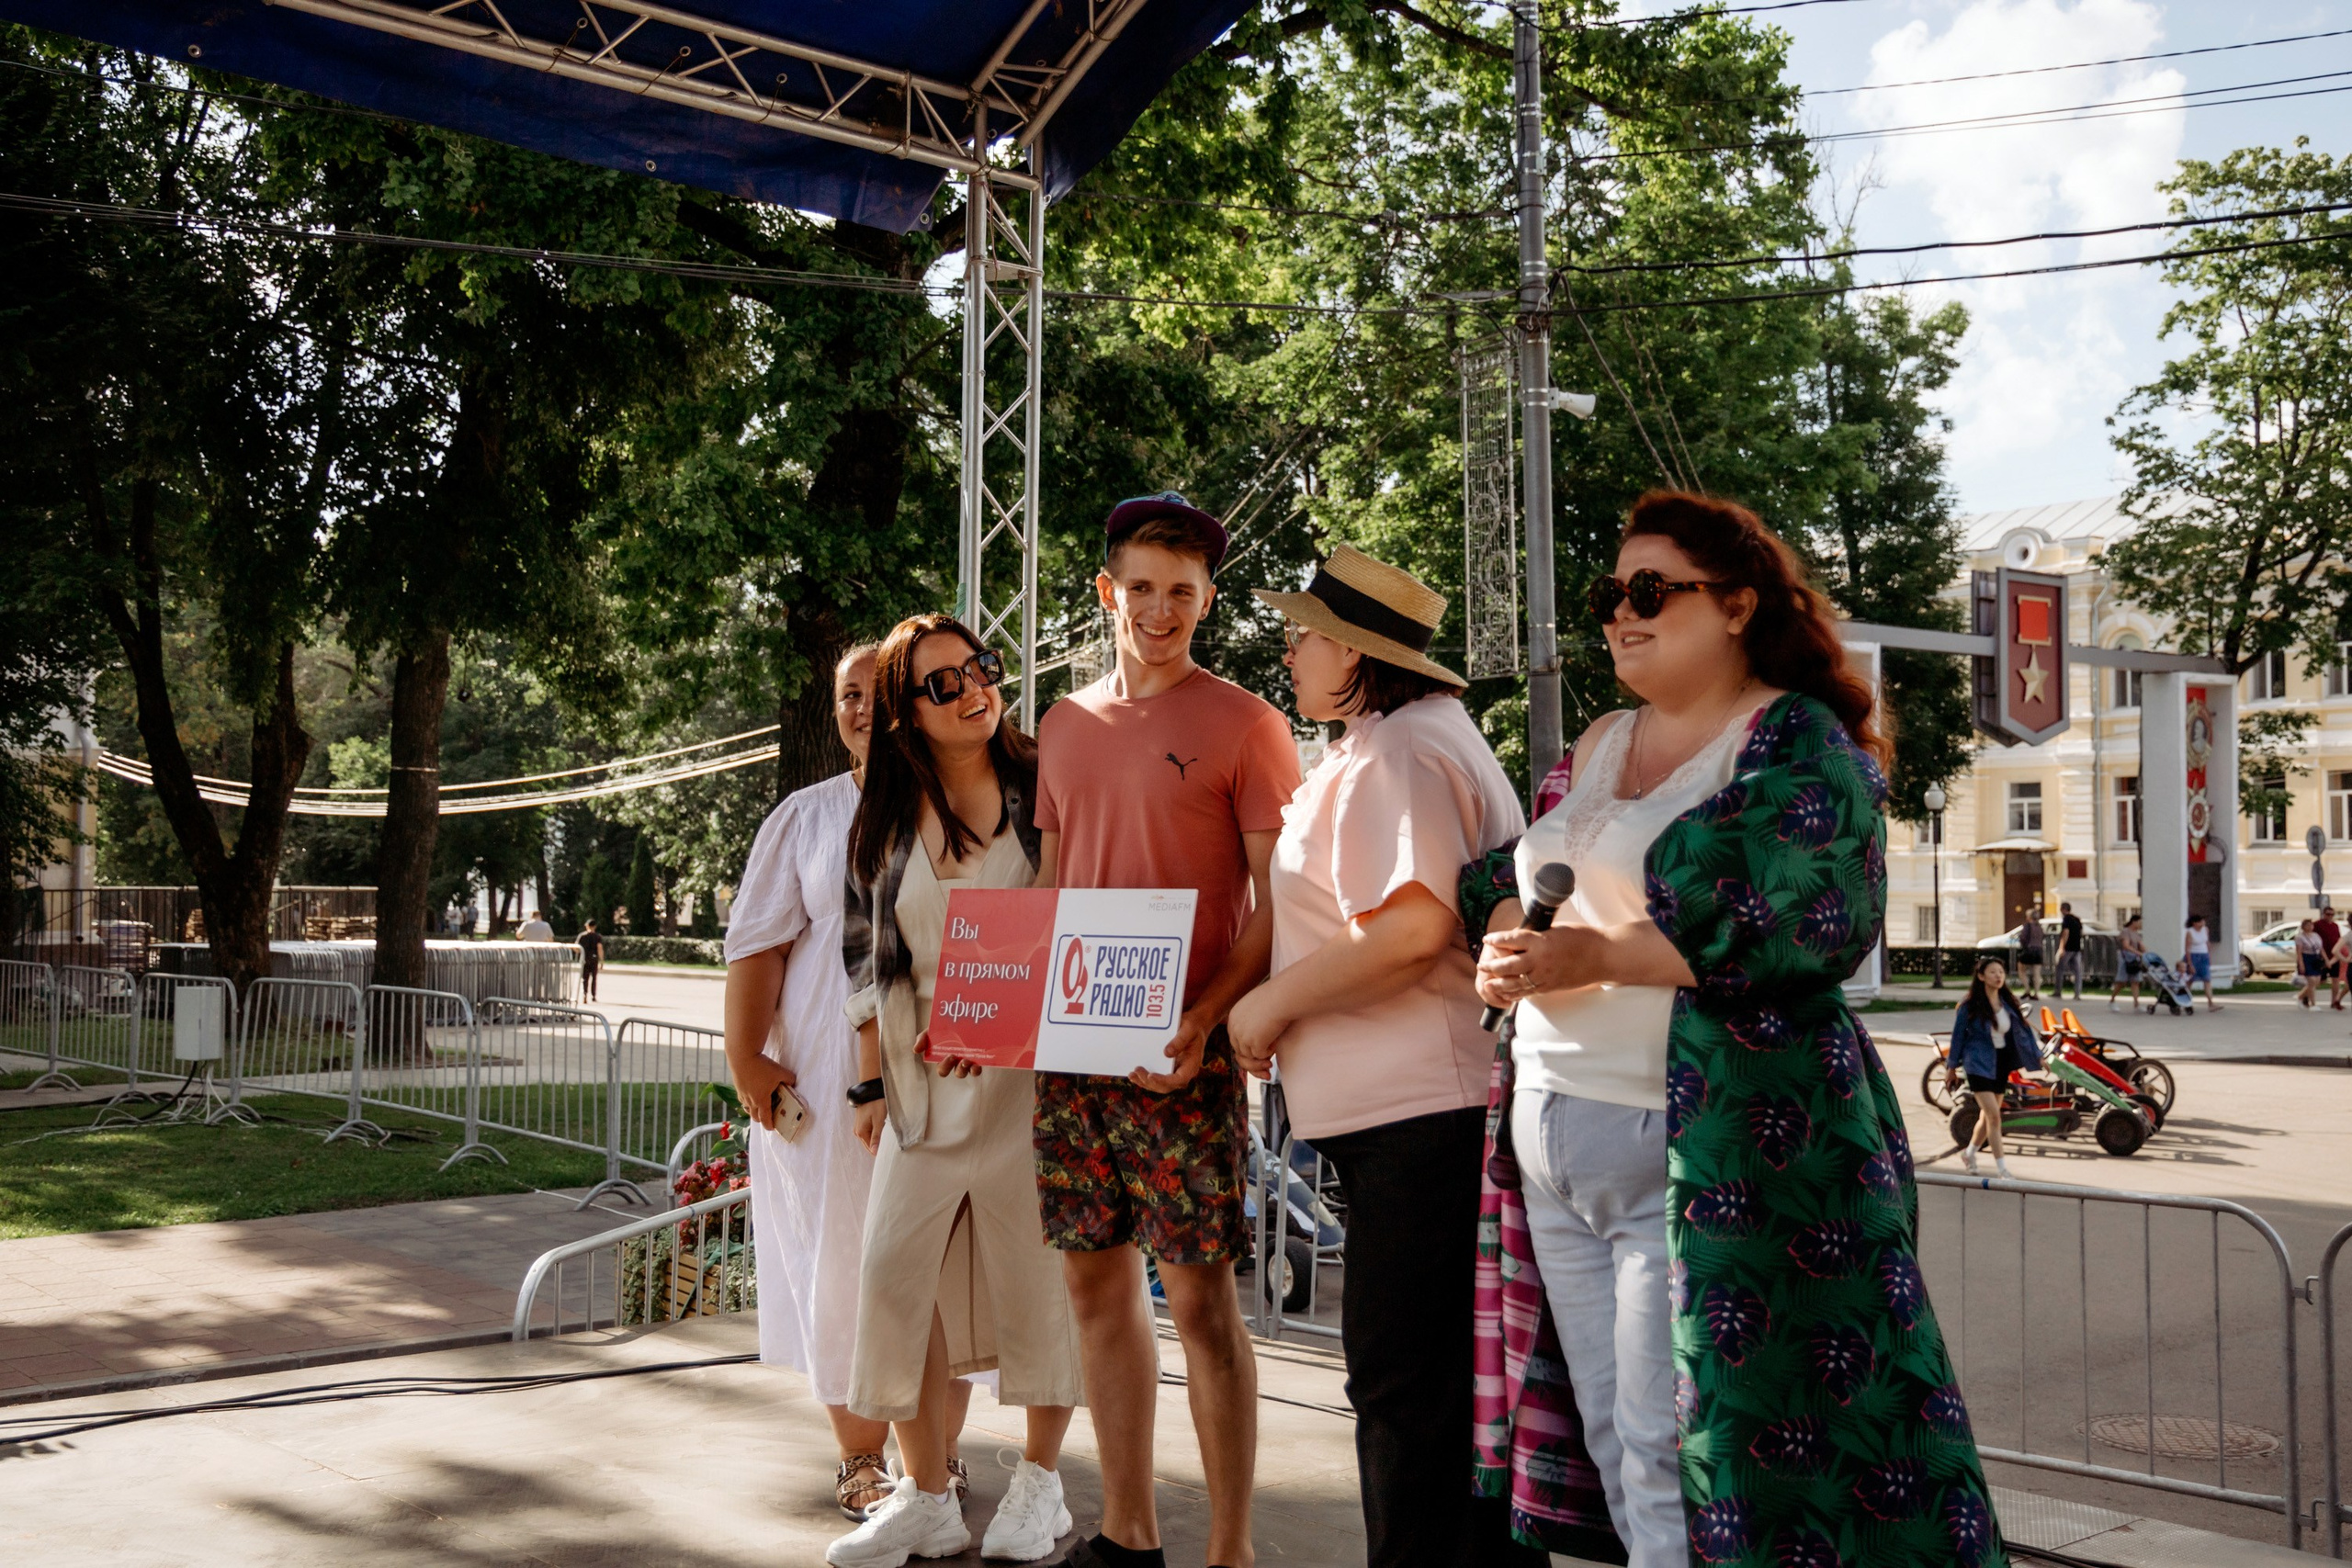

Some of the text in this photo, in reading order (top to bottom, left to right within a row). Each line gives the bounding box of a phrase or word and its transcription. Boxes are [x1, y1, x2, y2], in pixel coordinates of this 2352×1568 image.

[1148, 902, 1192, 912] MEDIAFM
[950, 917, 979, 940] Вы
[944, 963, 1031, 984] в прямом
[1094, 945, 1171, 981] РУССКОЕ
[939, 993, 999, 1024] эфире
[1090, 983, 1147, 1018] РАДИО
[1147, 984, 1166, 1018] 103.5
